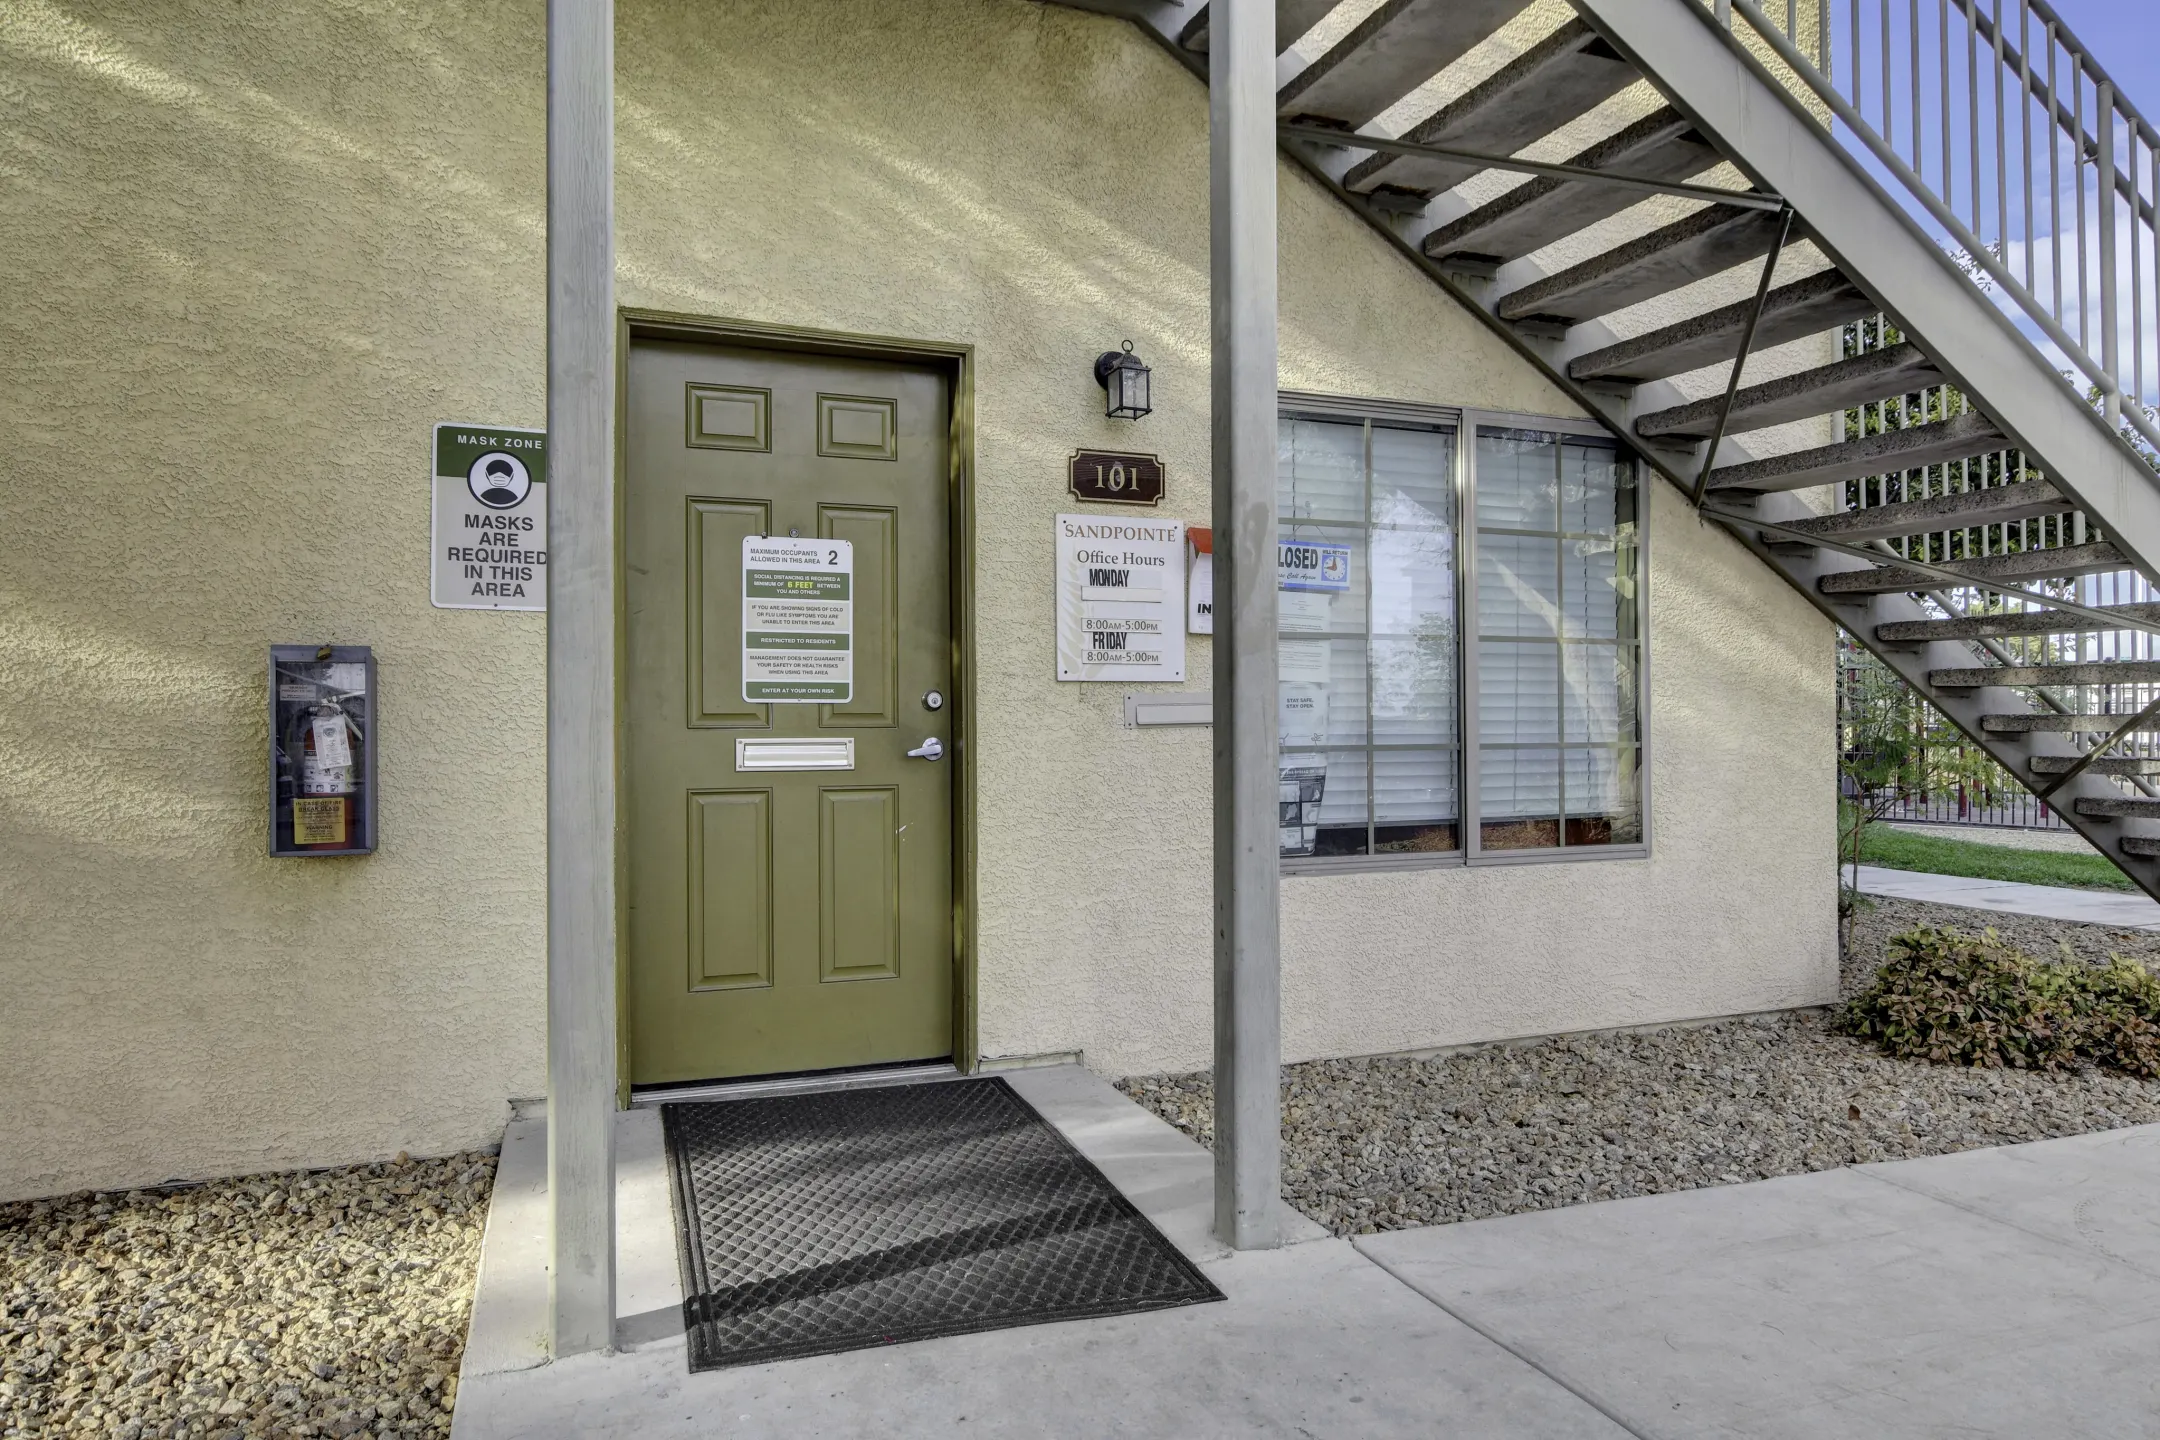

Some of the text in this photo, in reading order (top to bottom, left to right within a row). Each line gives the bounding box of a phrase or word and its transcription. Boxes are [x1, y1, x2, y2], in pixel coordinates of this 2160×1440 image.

[458, 435, 542, 449] MASK ZONE
[1095, 465, 1139, 491] 101
[465, 514, 533, 531] MASKS
[479, 532, 518, 547] ARE
[1065, 524, 1176, 543] SANDPOINTE
[448, 547, 546, 565] REQUIRED
[828, 550, 838, 565] 2
[1077, 550, 1165, 566] Office Hours
[1278, 547, 1318, 569] LOSED
[465, 565, 532, 581] IN THIS
[1089, 569, 1129, 587] MONDAY
[471, 582, 525, 597] AREA
[1093, 632, 1127, 650] FRIDAY
